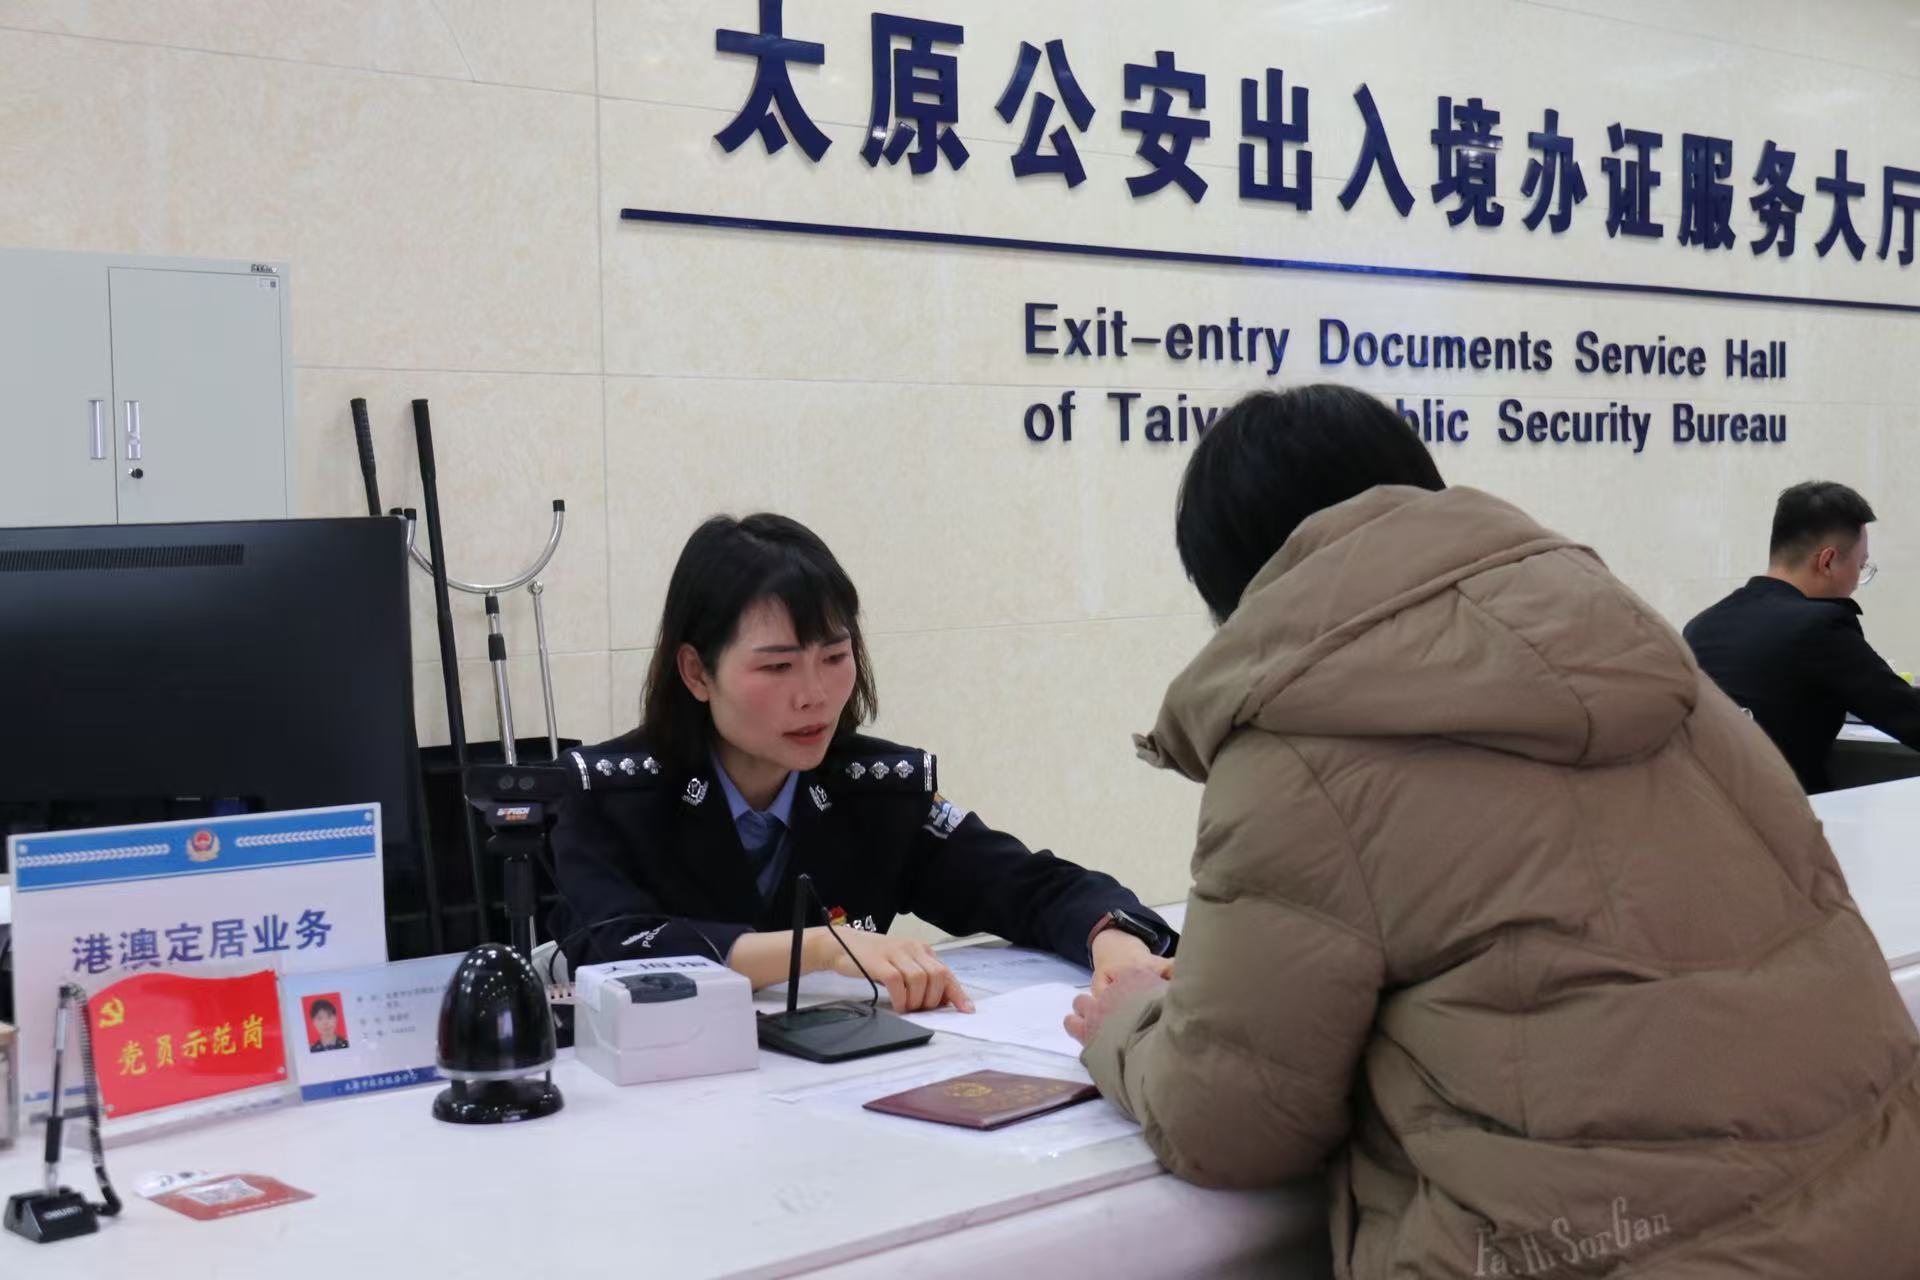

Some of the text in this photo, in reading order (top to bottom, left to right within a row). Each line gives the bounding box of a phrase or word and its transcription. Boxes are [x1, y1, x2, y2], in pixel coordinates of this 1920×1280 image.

[713, 0, 1920, 266] 太原公安出入境办证服务大厅
[1024, 301, 1787, 379] Exit-entry Documents Service Hall
[1023, 390, 1076, 443] of
[1497, 400, 1652, 452] Security
[1672, 403, 1787, 444] Bureau
[72, 909, 333, 974] 港澳定居业务
[117, 1013, 264, 1076] 党员示范岗
